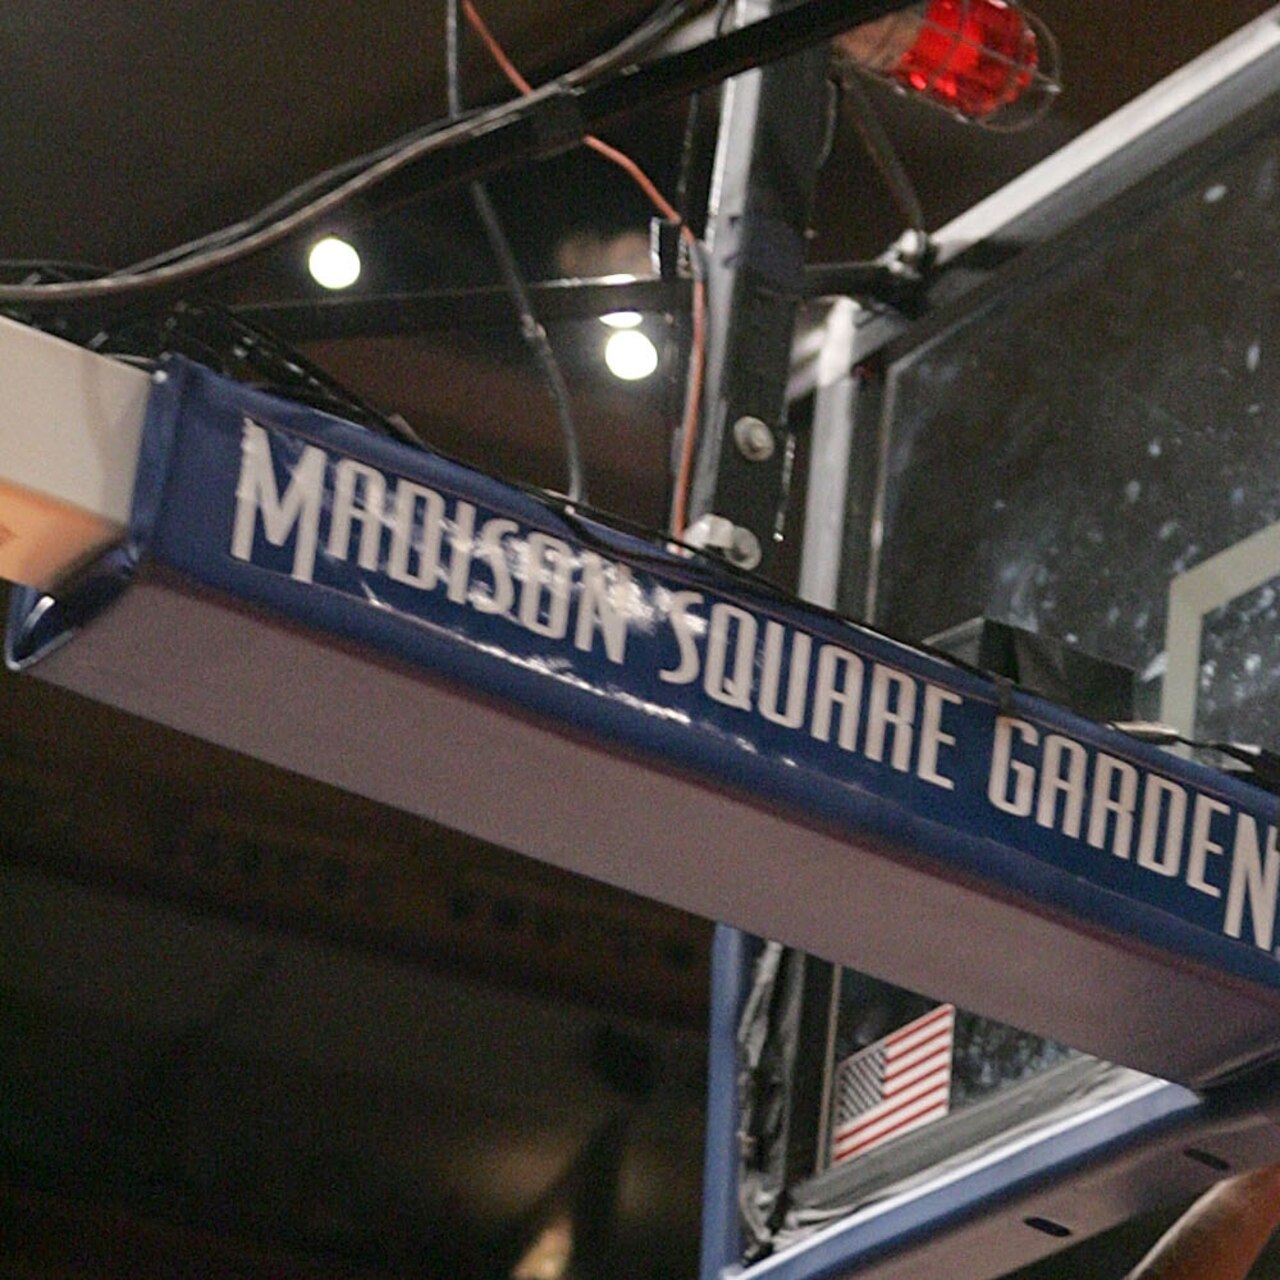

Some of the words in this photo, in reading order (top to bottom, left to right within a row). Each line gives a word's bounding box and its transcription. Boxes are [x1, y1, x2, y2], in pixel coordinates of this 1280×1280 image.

[230, 416, 634, 665] MADISON
[658, 590, 963, 792] SQUARE
[987, 715, 1280, 952] GARDEN
